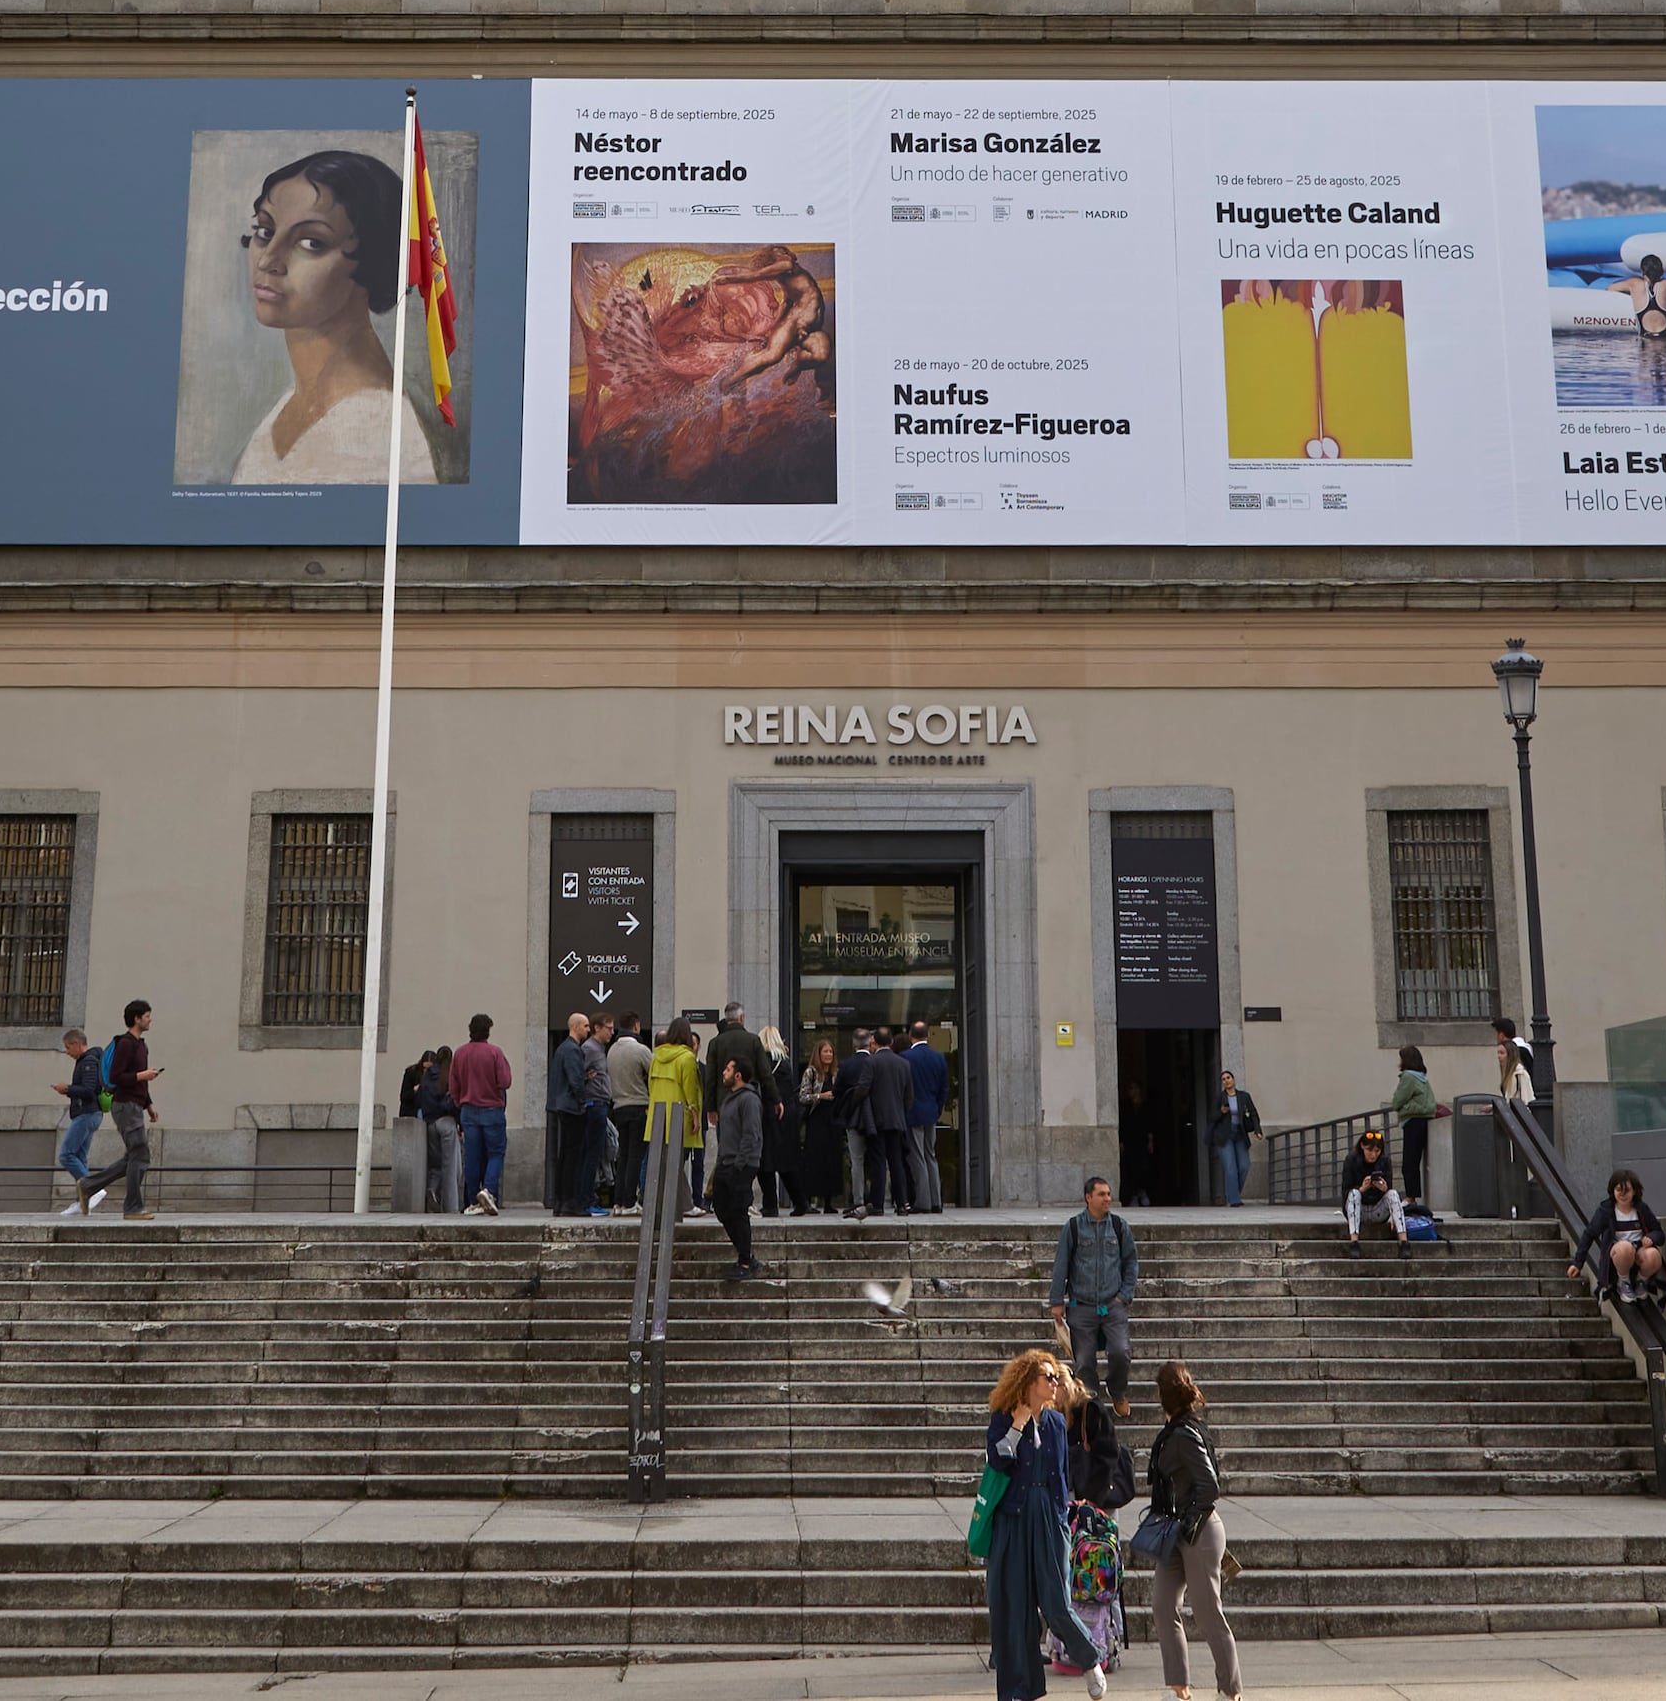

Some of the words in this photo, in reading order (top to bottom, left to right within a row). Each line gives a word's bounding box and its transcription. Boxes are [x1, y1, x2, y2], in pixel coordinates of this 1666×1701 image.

[576, 108, 590, 120] 14
[592, 108, 606, 120] de
[608, 111, 639, 122] mayo
[649, 108, 658, 120] 8
[660, 108, 674, 120] de
[676, 108, 741, 122] septiembre,
[743, 108, 775, 120] 2025
[890, 108, 904, 120] 21
[906, 108, 921, 120] de
[923, 111, 953, 122] mayo
[964, 108, 980, 120] 22
[982, 108, 996, 120] de
[998, 108, 1062, 122] septiembre,
[1064, 108, 1097, 121] 2025
[574, 131, 662, 154] Néstor
[890, 131, 978, 154] Marisa
[983, 131, 1102, 154] González
[573, 159, 748, 182] reencontrado
[890, 164, 914, 182] Un
[918, 164, 965, 182] modo
[968, 164, 989, 182] de
[992, 164, 1038, 182] hacer
[1041, 165, 1129, 186] generativo
[1215, 174, 1229, 186] 19
[1231, 174, 1245, 186] de
[1246, 174, 1283, 186] febrero
[1296, 174, 1312, 186] 25
[1313, 174, 1327, 186] de
[1329, 176, 1368, 189] agosto,
[1370, 174, 1401, 186] 2025
[1085, 210, 1128, 219] MADRID
[1215, 201, 1343, 229] Huguette
[1347, 201, 1441, 224] Caland
[1217, 238, 1260, 260] Una
[1264, 237, 1308, 260] vida
[1314, 244, 1339, 260] en
[1345, 244, 1408, 264] pocas
[1413, 237, 1475, 260] líneas
[893, 358, 911, 371] 28
[913, 358, 927, 370] de
[929, 361, 960, 373] mayo
[971, 358, 988, 370] 20
[990, 358, 1005, 370] de
[1007, 358, 1053, 372] octubre,
[1055, 358, 1089, 371] 2025
[893, 382, 989, 406] Naufus
[894, 412, 1131, 442] Ramírez-Figueroa
[1559, 423, 1576, 435] 26
[1578, 423, 1592, 435] de
[1593, 422, 1631, 434] febrero
[1644, 423, 1650, 434] 1
[1652, 423, 1666, 434] de
[894, 446, 980, 468] Espectros
[983, 445, 1071, 465] luminosos
[1562, 450, 1620, 474] Laia
[1565, 488, 1619, 511] Hello
[724, 705, 877, 744] REINA
[887, 704, 1037, 745] SOFIA
[774, 755, 815, 766] MUSEO
[817, 755, 877, 766] NACIONAL
[888, 755, 937, 766] CENTRO
[939, 755, 953, 766] DE
[957, 755, 985, 766] ARTE
[588, 867, 631, 875] VISITANTES
[588, 877, 607, 885] CON
[609, 877, 645, 885] ENTRADA
[588, 887, 621, 895] VISITORS
[588, 897, 609, 905] WITH
[611, 897, 635, 905] TICKET
[808, 933, 822, 943] A1
[835, 932, 887, 943] ENTRADA
[889, 932, 931, 943] MUSEO
[835, 946, 884, 957] MUSEUM
[888, 946, 947, 957] ENTRANCE
[587, 955, 628, 964] TAQUILLAS
[587, 965, 611, 973] TICKET
[613, 965, 641, 973] OFFICE
